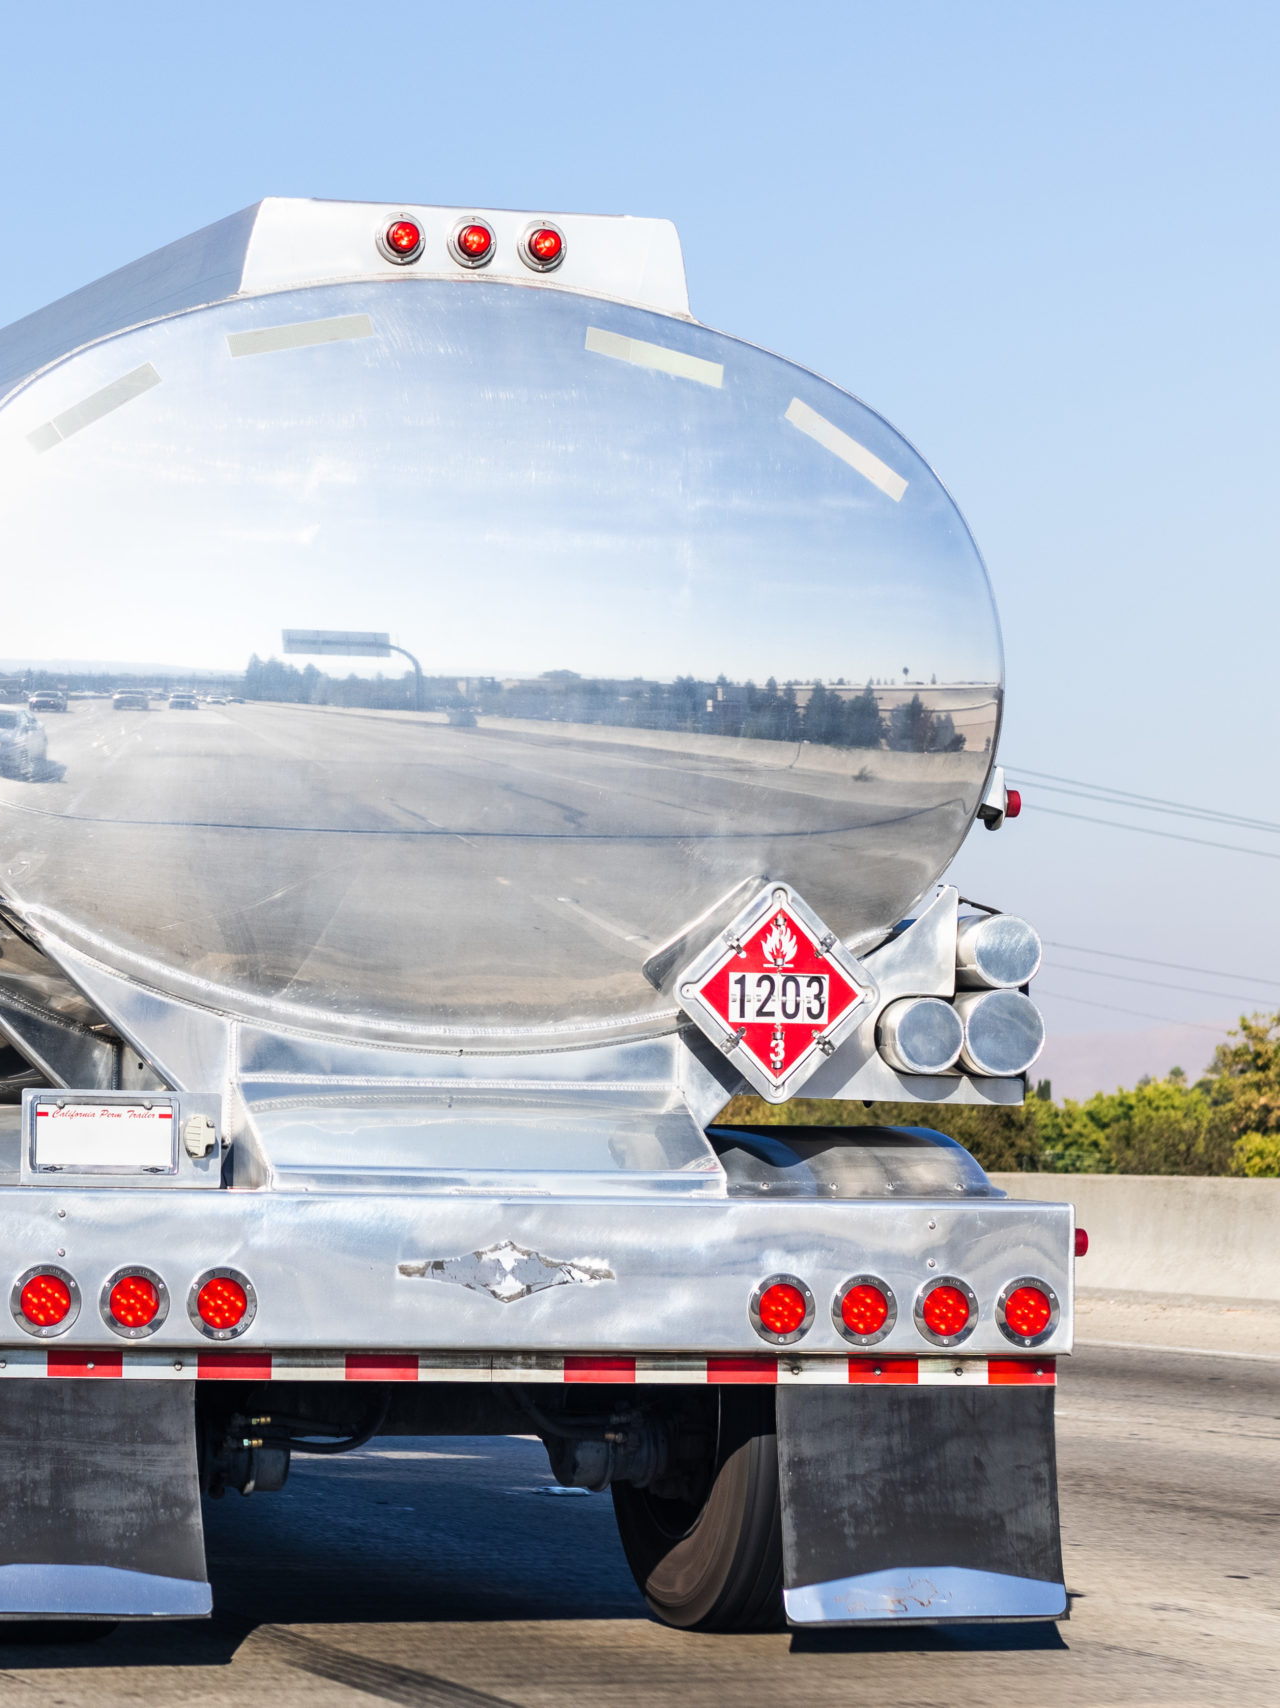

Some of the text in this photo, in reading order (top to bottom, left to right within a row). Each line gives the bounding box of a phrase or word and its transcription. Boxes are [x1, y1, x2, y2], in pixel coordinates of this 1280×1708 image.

[734, 974, 825, 1020] 1203
[770, 1039, 785, 1062] 3
[52, 1109, 155, 1120] California Perm Trailer
